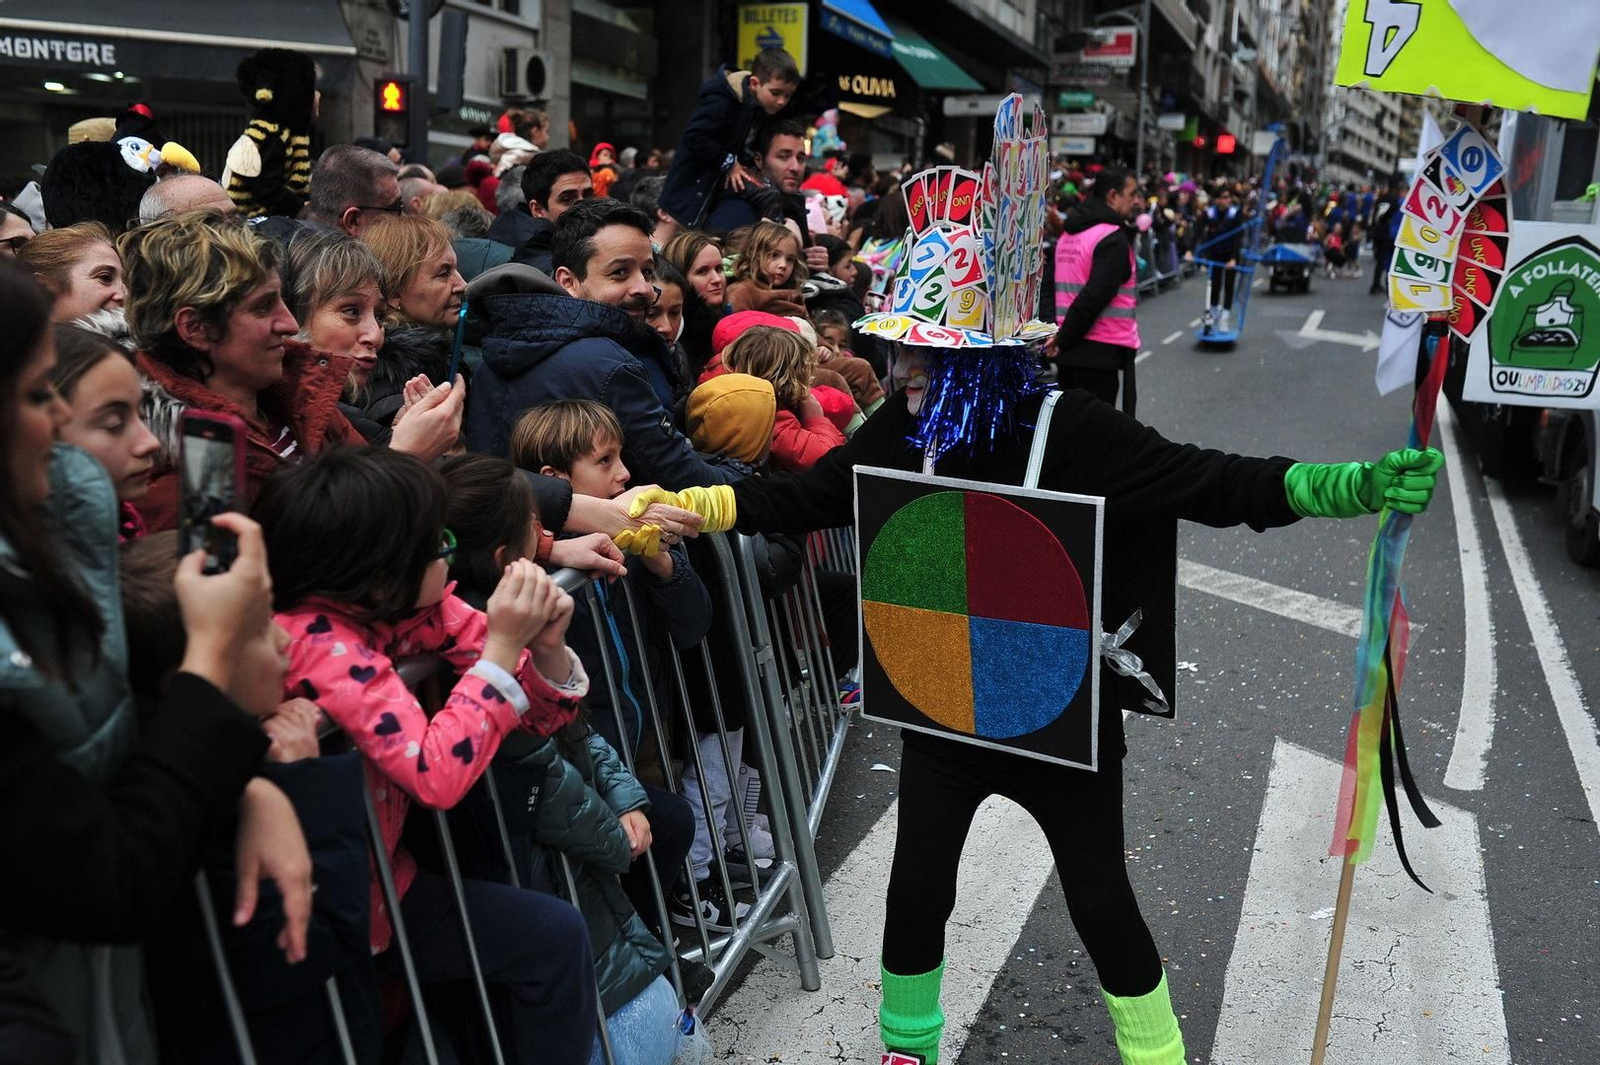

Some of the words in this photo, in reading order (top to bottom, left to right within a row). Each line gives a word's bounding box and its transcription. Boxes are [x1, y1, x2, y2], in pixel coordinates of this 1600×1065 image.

[743, 8, 798, 24] BILLETES
[1363, 0, 1422, 78] 4
[911, 195, 924, 217] UNO
[953, 195, 971, 207] UNO
[1427, 195, 1448, 219] 2
[1420, 225, 1440, 243] 0
[953, 248, 969, 270] 2
[1464, 267, 1477, 296] UNO
[1509, 284, 1524, 298] A
[924, 282, 943, 303] 2
[960, 289, 975, 310] 9
[1449, 295, 1465, 324] UNO
